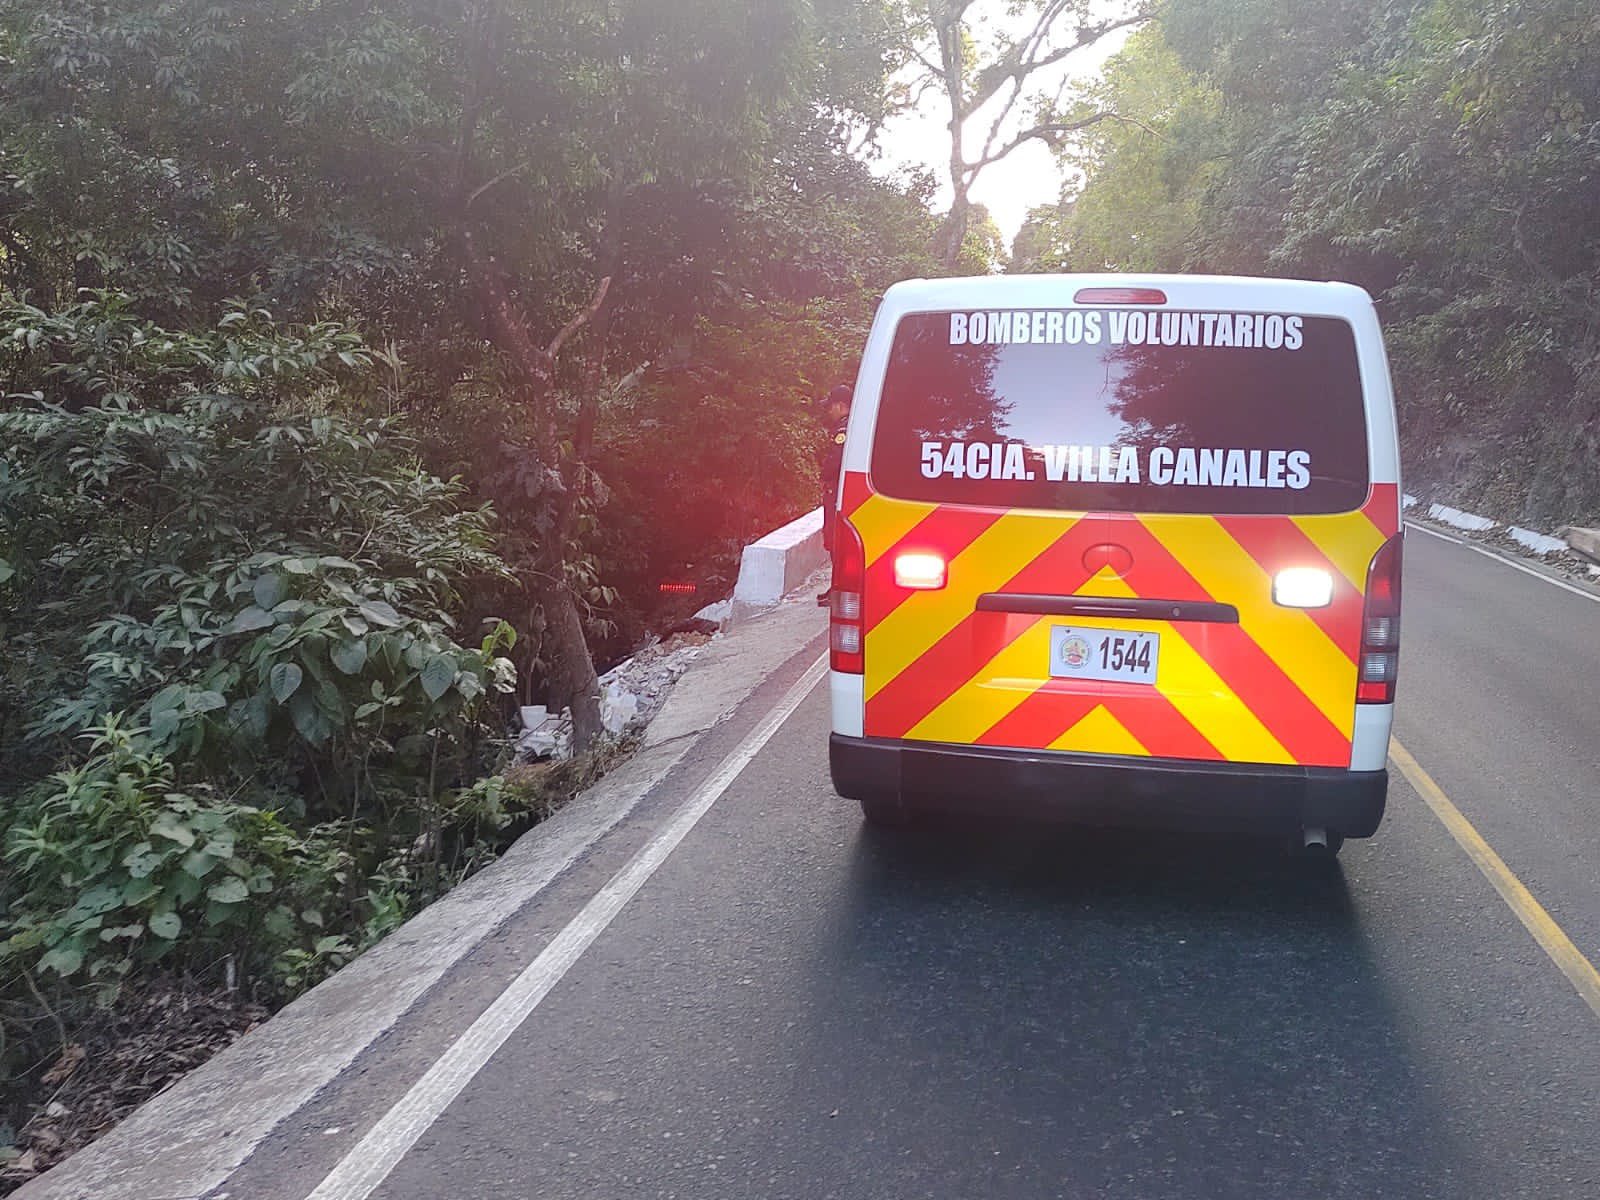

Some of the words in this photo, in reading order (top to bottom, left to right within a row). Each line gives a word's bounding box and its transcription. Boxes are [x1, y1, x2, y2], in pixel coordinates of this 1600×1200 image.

[949, 311, 1102, 345] BOMBEROS
[1108, 311, 1303, 350] VOLUNTARIOS
[920, 442, 1035, 480] 54CIA.
[1042, 444, 1140, 483] VILLA
[1149, 447, 1311, 489] CANALES
[1100, 636, 1151, 674] 1544
